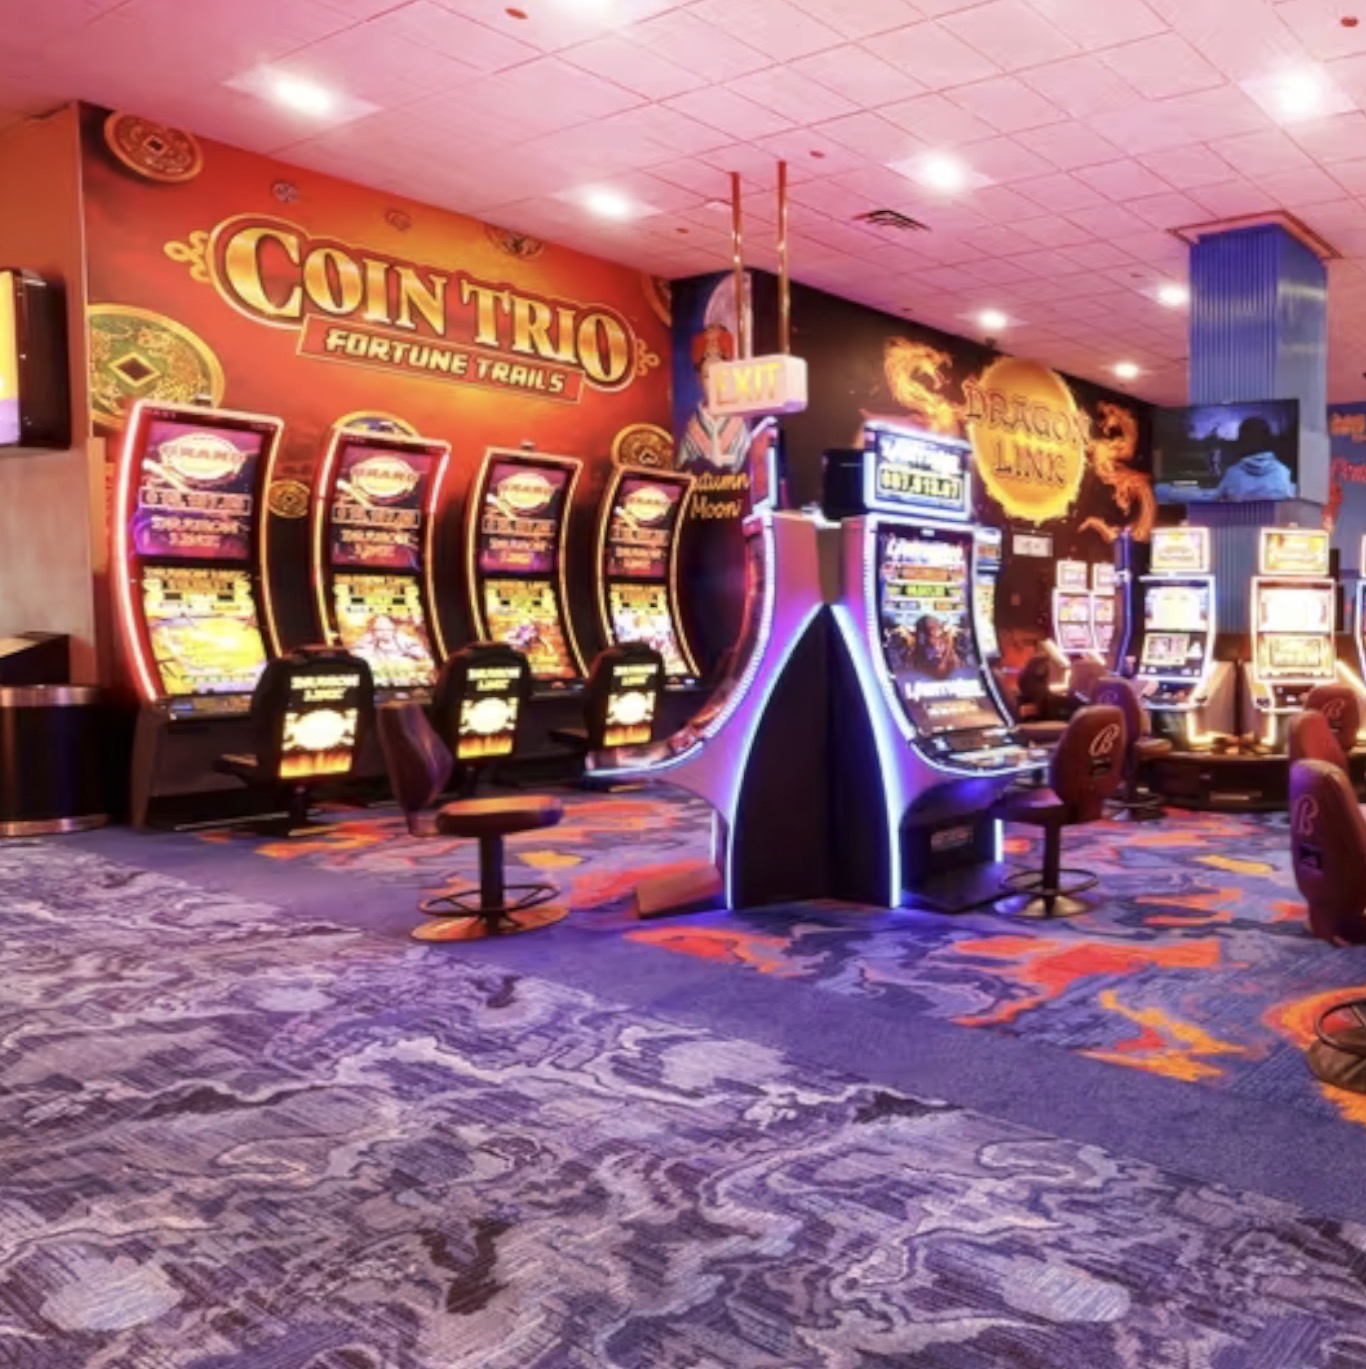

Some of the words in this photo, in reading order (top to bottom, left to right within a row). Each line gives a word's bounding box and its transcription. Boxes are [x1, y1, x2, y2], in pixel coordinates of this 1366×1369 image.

[225, 227, 449, 336] COIN
[461, 279, 629, 383] TRIO
[326, 328, 468, 375] FORTUNE
[475, 357, 566, 393] TRAILS
[714, 362, 782, 405] EXIT
[964, 382, 1091, 447] DRAGON
[995, 438, 1066, 486] LINK
[1089, 723, 1121, 757] B
